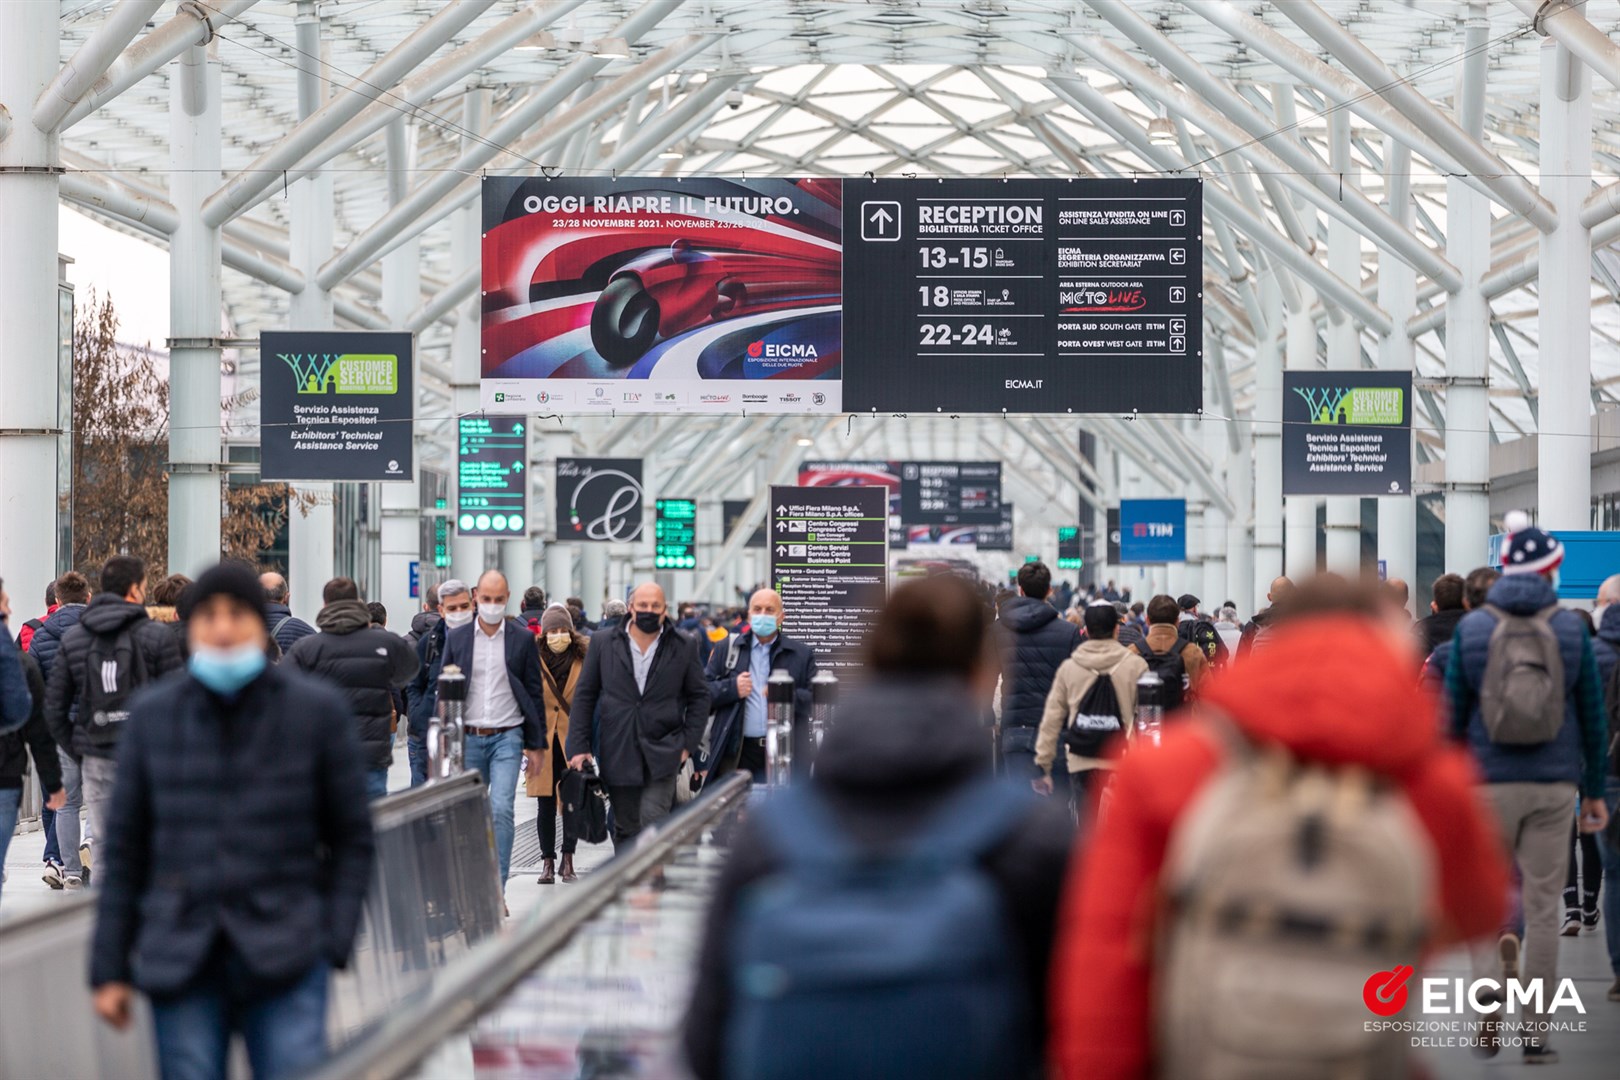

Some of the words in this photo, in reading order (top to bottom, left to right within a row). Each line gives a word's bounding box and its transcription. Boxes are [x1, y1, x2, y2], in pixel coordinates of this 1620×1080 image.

[524, 195, 585, 214] OGGI
[594, 195, 671, 214] RIAPRE
[680, 195, 696, 214] IL
[705, 196, 799, 214] FUTURO.
[919, 206, 1043, 224] RECEPTION
[552, 220, 580, 228] 23/28
[583, 220, 635, 228] NOVEMBRE
[638, 220, 664, 228] 2021.
[666, 220, 715, 228] NOVEMBER
[717, 220, 743, 228] 23/28
[919, 225, 979, 233] BIGLIETTERIA
[981, 225, 1010, 233] TICKET
[1012, 225, 1043, 233] OFFICE
[919, 247, 988, 269] 13-15
[919, 285, 949, 308] 18
[920, 324, 994, 345] 22-24
[765, 345, 818, 357] EICMA
[340, 360, 393, 372] CUSTOMER
[340, 371, 393, 385] SERVICE
[1005, 379, 1044, 390] EICMA.IT
[1352, 390, 1399, 400] CUSTOMER
[294, 405, 329, 414] Servizio
[331, 405, 379, 414] Assistenza
[1352, 400, 1398, 412] SERVICE
[296, 416, 330, 424] Tecnica
[332, 416, 377, 425] Espositori
[291, 431, 339, 440] Exhibitors'
[341, 431, 383, 440] Technical
[1306, 434, 1338, 442] Servizio
[1340, 434, 1383, 442] Assistenza
[294, 442, 344, 450] Assistance
[345, 442, 379, 450] Service
[1308, 444, 1338, 452] Tecnica
[1340, 444, 1380, 453] Espositori
[1306, 453, 1348, 462] Exhibitors'
[1350, 453, 1387, 462] Technical
[1309, 464, 1353, 472] Assistance
[1354, 464, 1383, 472] Service
[842, 505, 860, 513] S.p.A.
[829, 520, 859, 528] Congressi
[1149, 523, 1173, 537] TIM
